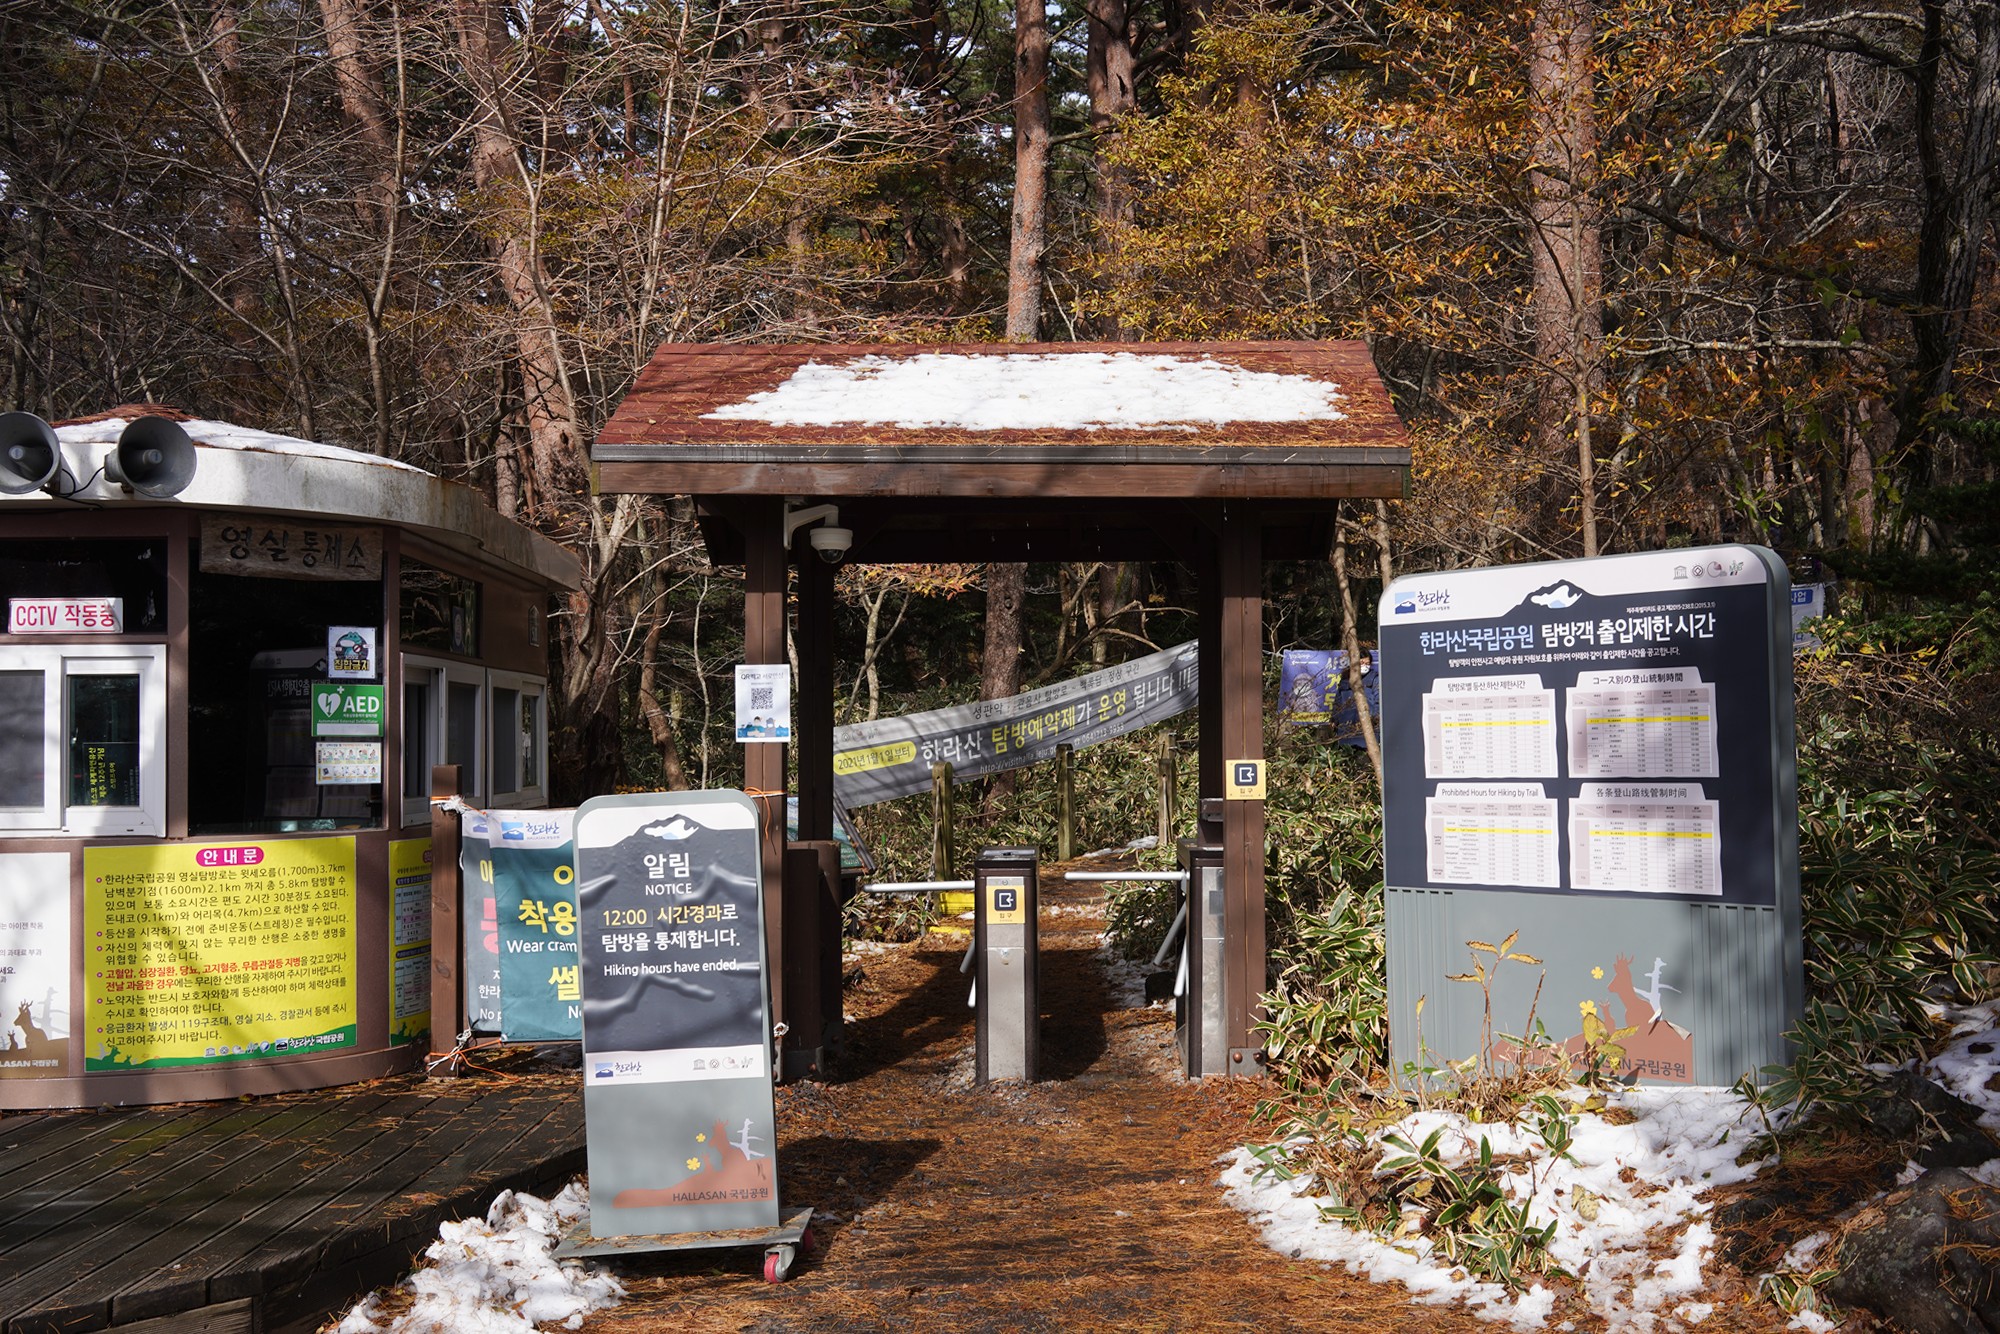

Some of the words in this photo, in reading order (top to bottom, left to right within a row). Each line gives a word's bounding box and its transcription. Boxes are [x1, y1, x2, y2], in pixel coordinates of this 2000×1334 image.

[1417, 589, 1450, 606] 한라산
[16, 605, 58, 626] CCTV
[64, 604, 114, 627] 작동중
[1420, 625, 1534, 655] 한라산국립공원
[1542, 620, 1594, 648] 탐방객
[1597, 615, 1672, 644] 출입제한
[1675, 612, 1716, 638] 시간
[1471, 656, 1494, 666] 안전사고
[1512, 655, 1524, 664] 공원
[1553, 652, 1571, 662] 위하여
[1572, 650, 1589, 660] 아래와
[1590, 650, 1602, 660] 같이
[1603, 649, 1627, 660] 출입제한
[1628, 648, 1646, 658] 시간을
[1448, 682, 1472, 692] 탐방로별
[1593, 672, 1684, 684] コース別の登山統制時間
[343, 696, 380, 712] AED
[973, 702, 1002, 720] 성판악
[920, 730, 982, 770] 한라산
[992, 700, 1092, 754] 탐방예약제가
[1098, 688, 1126, 722] 운영
[1134, 672, 1174, 710] 됩니다
[1442, 788, 1470, 796] Prohibited
[1471, 788, 1488, 796] Hours
[1488, 788, 1497, 796] for
[1498, 788, 1517, 798] Hiking
[1517, 789, 1525, 798] by
[1596, 788, 1688, 798] 各条登山路线管制时间
[526, 822, 560, 836] 한라산
[644, 852, 690, 879] 알림
[105, 872, 176, 886] 한라산국립공원
[178, 870, 238, 882] 영실탐방로는
[244, 881, 263, 890] 까지
[266, 880, 276, 890] 총
[279, 879, 308, 889] 5.8km
[311, 876, 336, 887] 탐방할
[338, 875, 346, 885] 수
[645, 883, 692, 896] NOTICE
[105, 901, 136, 911] 있으며
[144, 900, 164, 909] 보통
[168, 896, 218, 908] 소요시간은
[222, 895, 240, 906] 편도
[245, 894, 270, 904] 2시간
[274, 892, 312, 902] 30분정도
[314, 888, 349, 899] 소요된다.
[105, 911, 190, 925] 돈내코(9.1km)와
[192, 905, 281, 920] 어리목(4.7km)으로
[284, 904, 309, 914] 하산할
[311, 903, 320, 912] 수
[321, 901, 340, 912] 있다.
[518, 900, 577, 936] 착용
[603, 909, 647, 926] 12:00
[657, 904, 739, 924] 시간경과로
[8, 922, 29, 930] 아이젠
[30, 922, 44, 930] 착용
[105, 928, 136, 940] 등산을
[140, 926, 181, 938] 시작하기
[185, 924, 205, 935] 전에
[209, 918, 304, 934] 준비운동(스트레칭)은
[306, 914, 349, 927] 필수입니다.
[105, 942, 137, 953] 자신의
[142, 940, 174, 951] 체력에
[178, 939, 198, 950] 맞지
[203, 938, 223, 948] 않는
[228, 935, 257, 946] 무리한
[261, 932, 289, 944] 산행은
[293, 930, 319, 942] 소중한
[322, 927, 347, 939] 생명을
[506, 940, 544, 953] Wear
[548, 941, 577, 952] cram
[602, 932, 651, 953] 탐방을
[654, 928, 740, 950] 통제합니다.
[105, 954, 137, 965] 위협할
[142, 953, 152, 964] 수
[157, 951, 203, 963] 있습니다.
[242, 959, 284, 971] 무릎관절등
[284, 955, 308, 967] 지병을
[310, 954, 325, 965] 갖고
[325, 952, 347, 963] 있거나
[604, 964, 639, 977] Hiking
[641, 962, 672, 974] hours
[674, 961, 700, 973] have
[702, 958, 740, 971] ended.
[106, 981, 125, 992] 전날
[126, 979, 154, 991] 과음한
[156, 978, 194, 990] 경우에는
[195, 976, 221, 986] 무리한
[224, 973, 250, 985] 산행을
[252, 970, 285, 981] 자제하여
[287, 968, 311, 979] 주시기
[312, 964, 343, 976] 바랍니다.
[105, 994, 146, 1006] 노약자는
[148, 992, 178, 1004] 반드시
[182, 988, 239, 1000] 보호자와함께
[242, 985, 286, 997] 등산하여야
[289, 982, 306, 992] 하며
[308, 977, 347, 990] 체력상태를
[105, 1008, 136, 1019] 수시로
[140, 1005, 189, 1017] 확인하여야
[192, 1002, 224, 1014] 합니다.
[105, 1022, 145, 1034] 응급환자
[148, 1020, 178, 1031] 발생시
[235, 1014, 253, 1025] 영실
[280, 1008, 312, 1020] 경찰관서
[314, 1006, 330, 1016] 등에
[332, 1003, 347, 1013] 즉시
[480, 1008, 495, 1020] No
[105, 1034, 176, 1048] 신고하여주시기
[179, 1030, 222, 1042] 바랍니다.
[288, 1034, 314, 1048] 한라산
[315, 1032, 345, 1044] 국립공원
[615, 1061, 642, 1073] 한라산
[1635, 1058, 1686, 1078] 국립공원
[672, 1191, 727, 1202] HALLASAN
[729, 1188, 768, 1199] 국립공원
